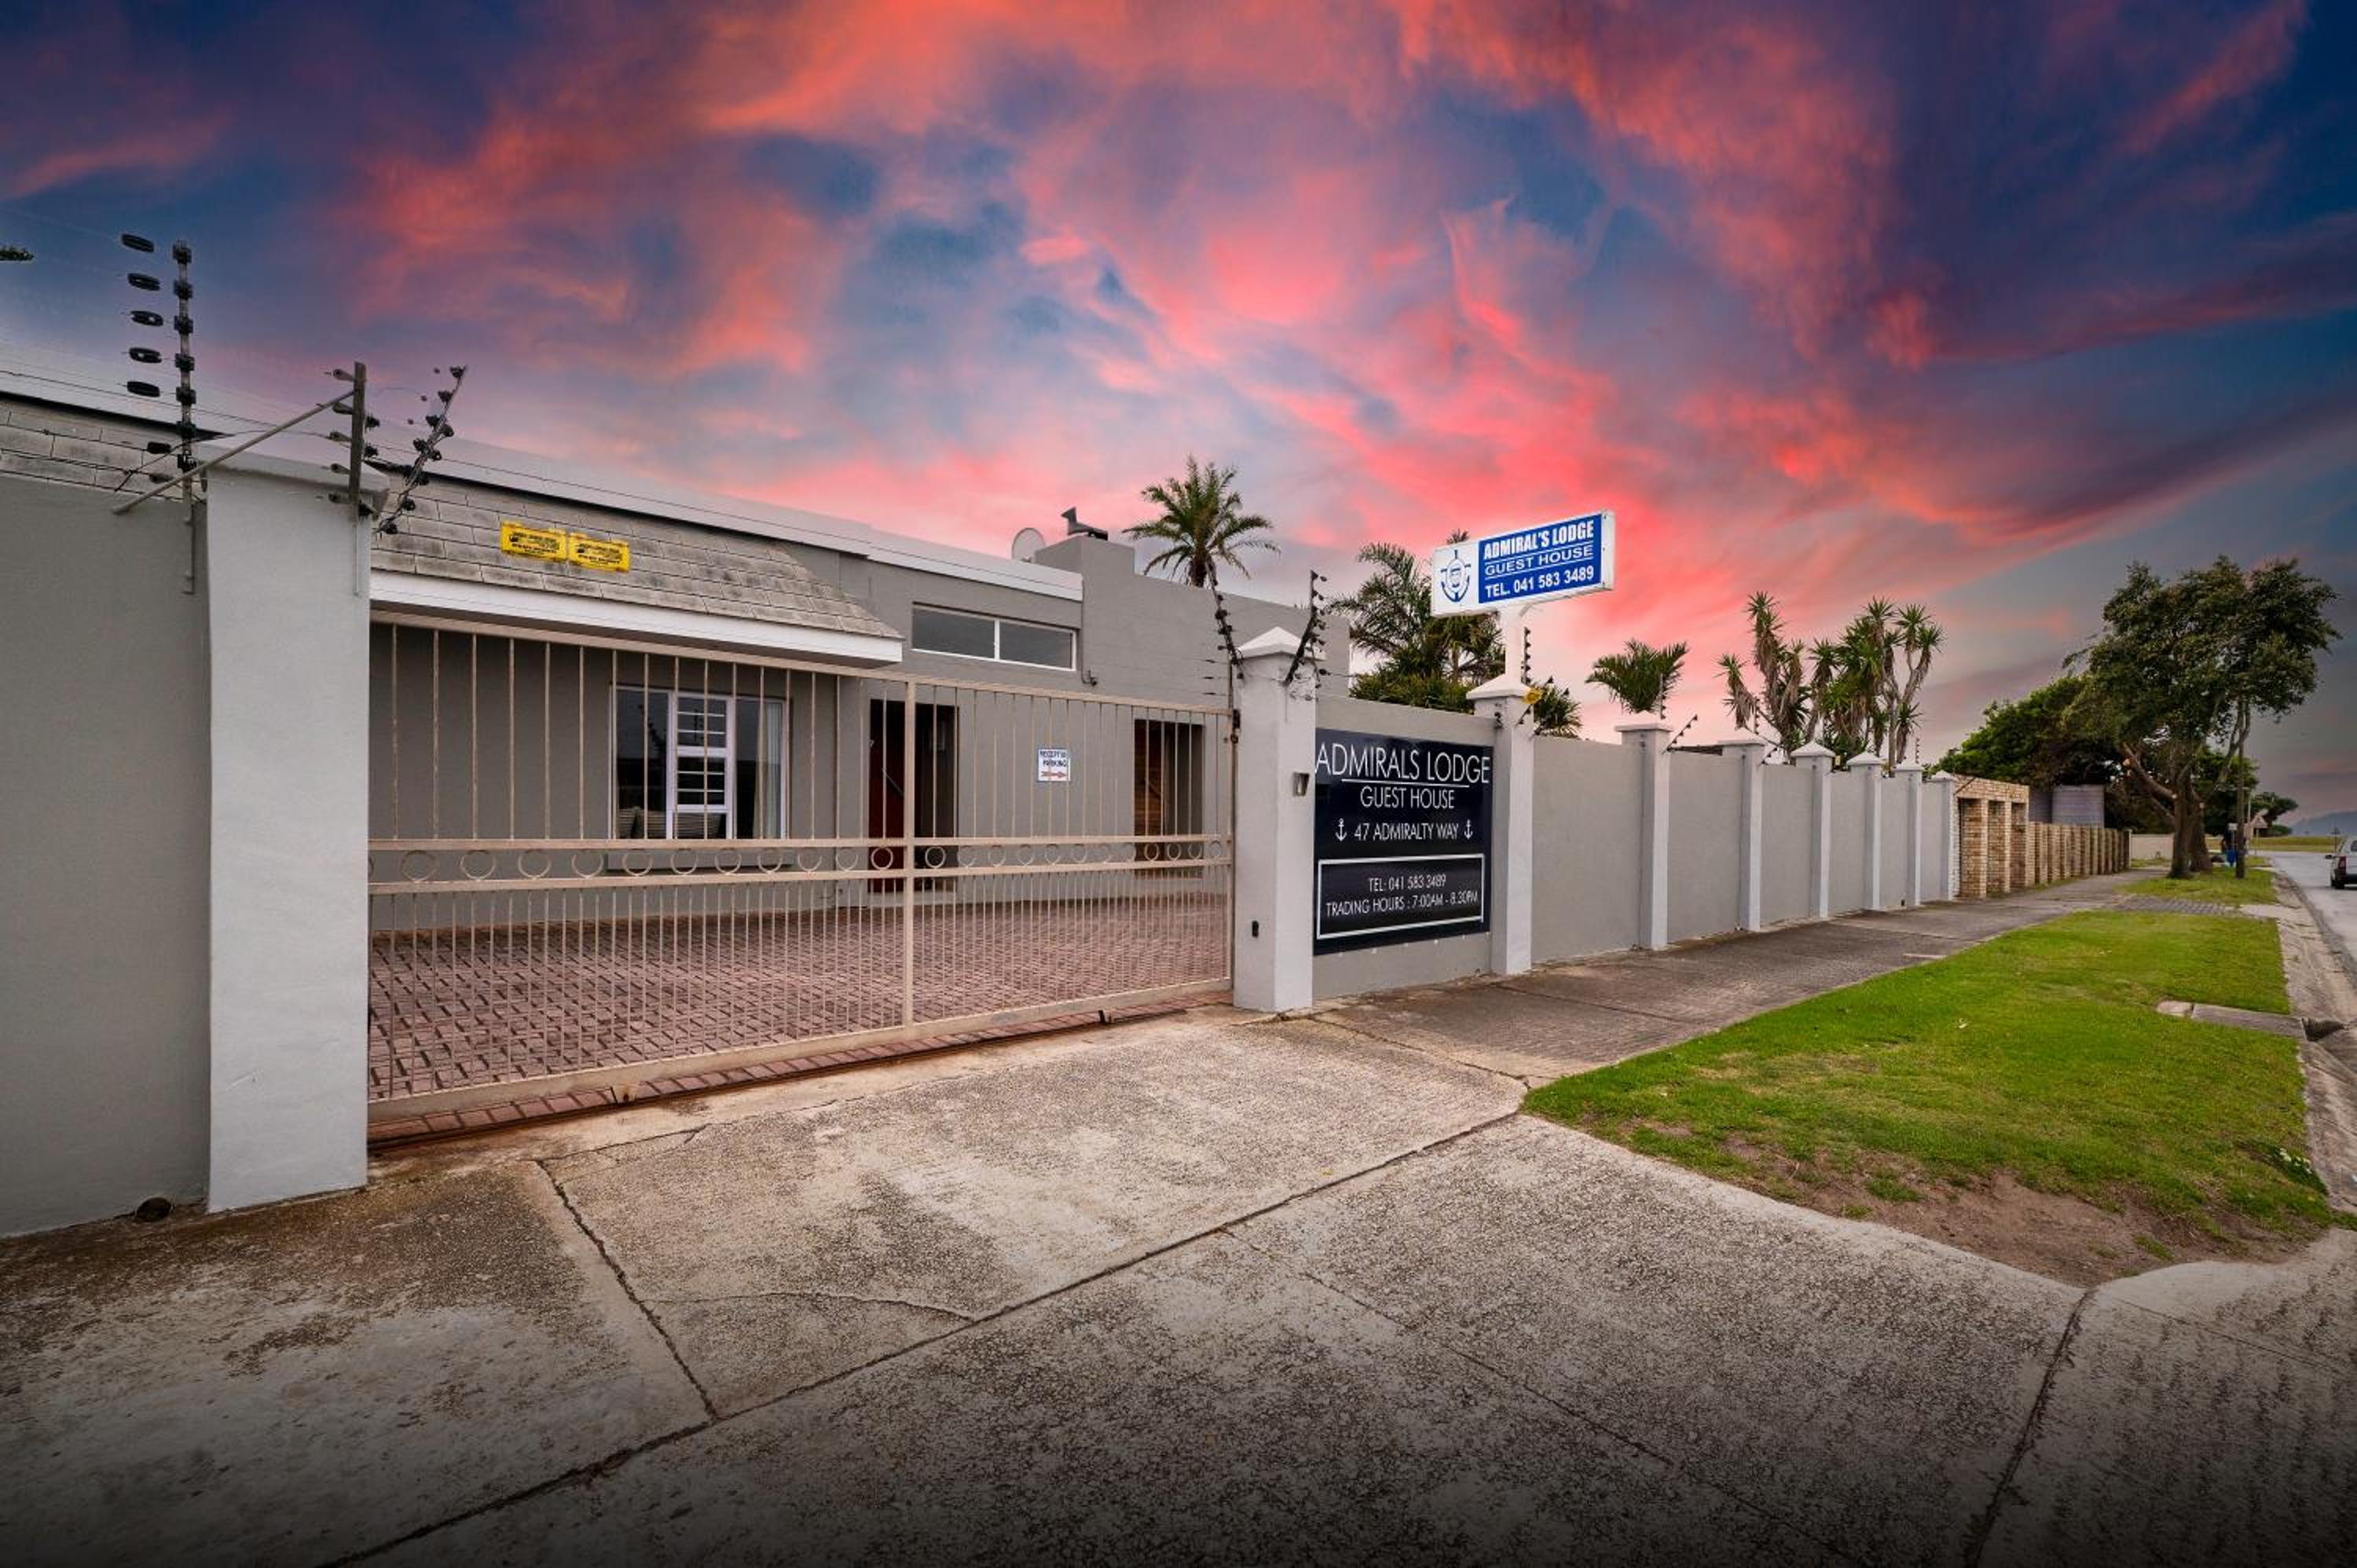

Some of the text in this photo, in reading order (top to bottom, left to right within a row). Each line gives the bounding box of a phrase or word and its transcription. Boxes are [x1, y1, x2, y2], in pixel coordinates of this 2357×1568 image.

[1483, 520, 1594, 560] ADMIRAL'S LODGE
[1485, 545, 1593, 576] GUEST HOUSE
[1485, 566, 1594, 598] TEL. 041 583 3489
[1315, 743, 1490, 783] ADMIRALS LODGE
[1360, 786, 1455, 809] GUEST HOUSE
[1354, 822, 1459, 841] 47 ADMIRALTY WAY
[1368, 874, 1446, 893] TEL: 041 583 3489
[1326, 899, 1370, 918] TRADING
[1373, 896, 1406, 913] HOURS
